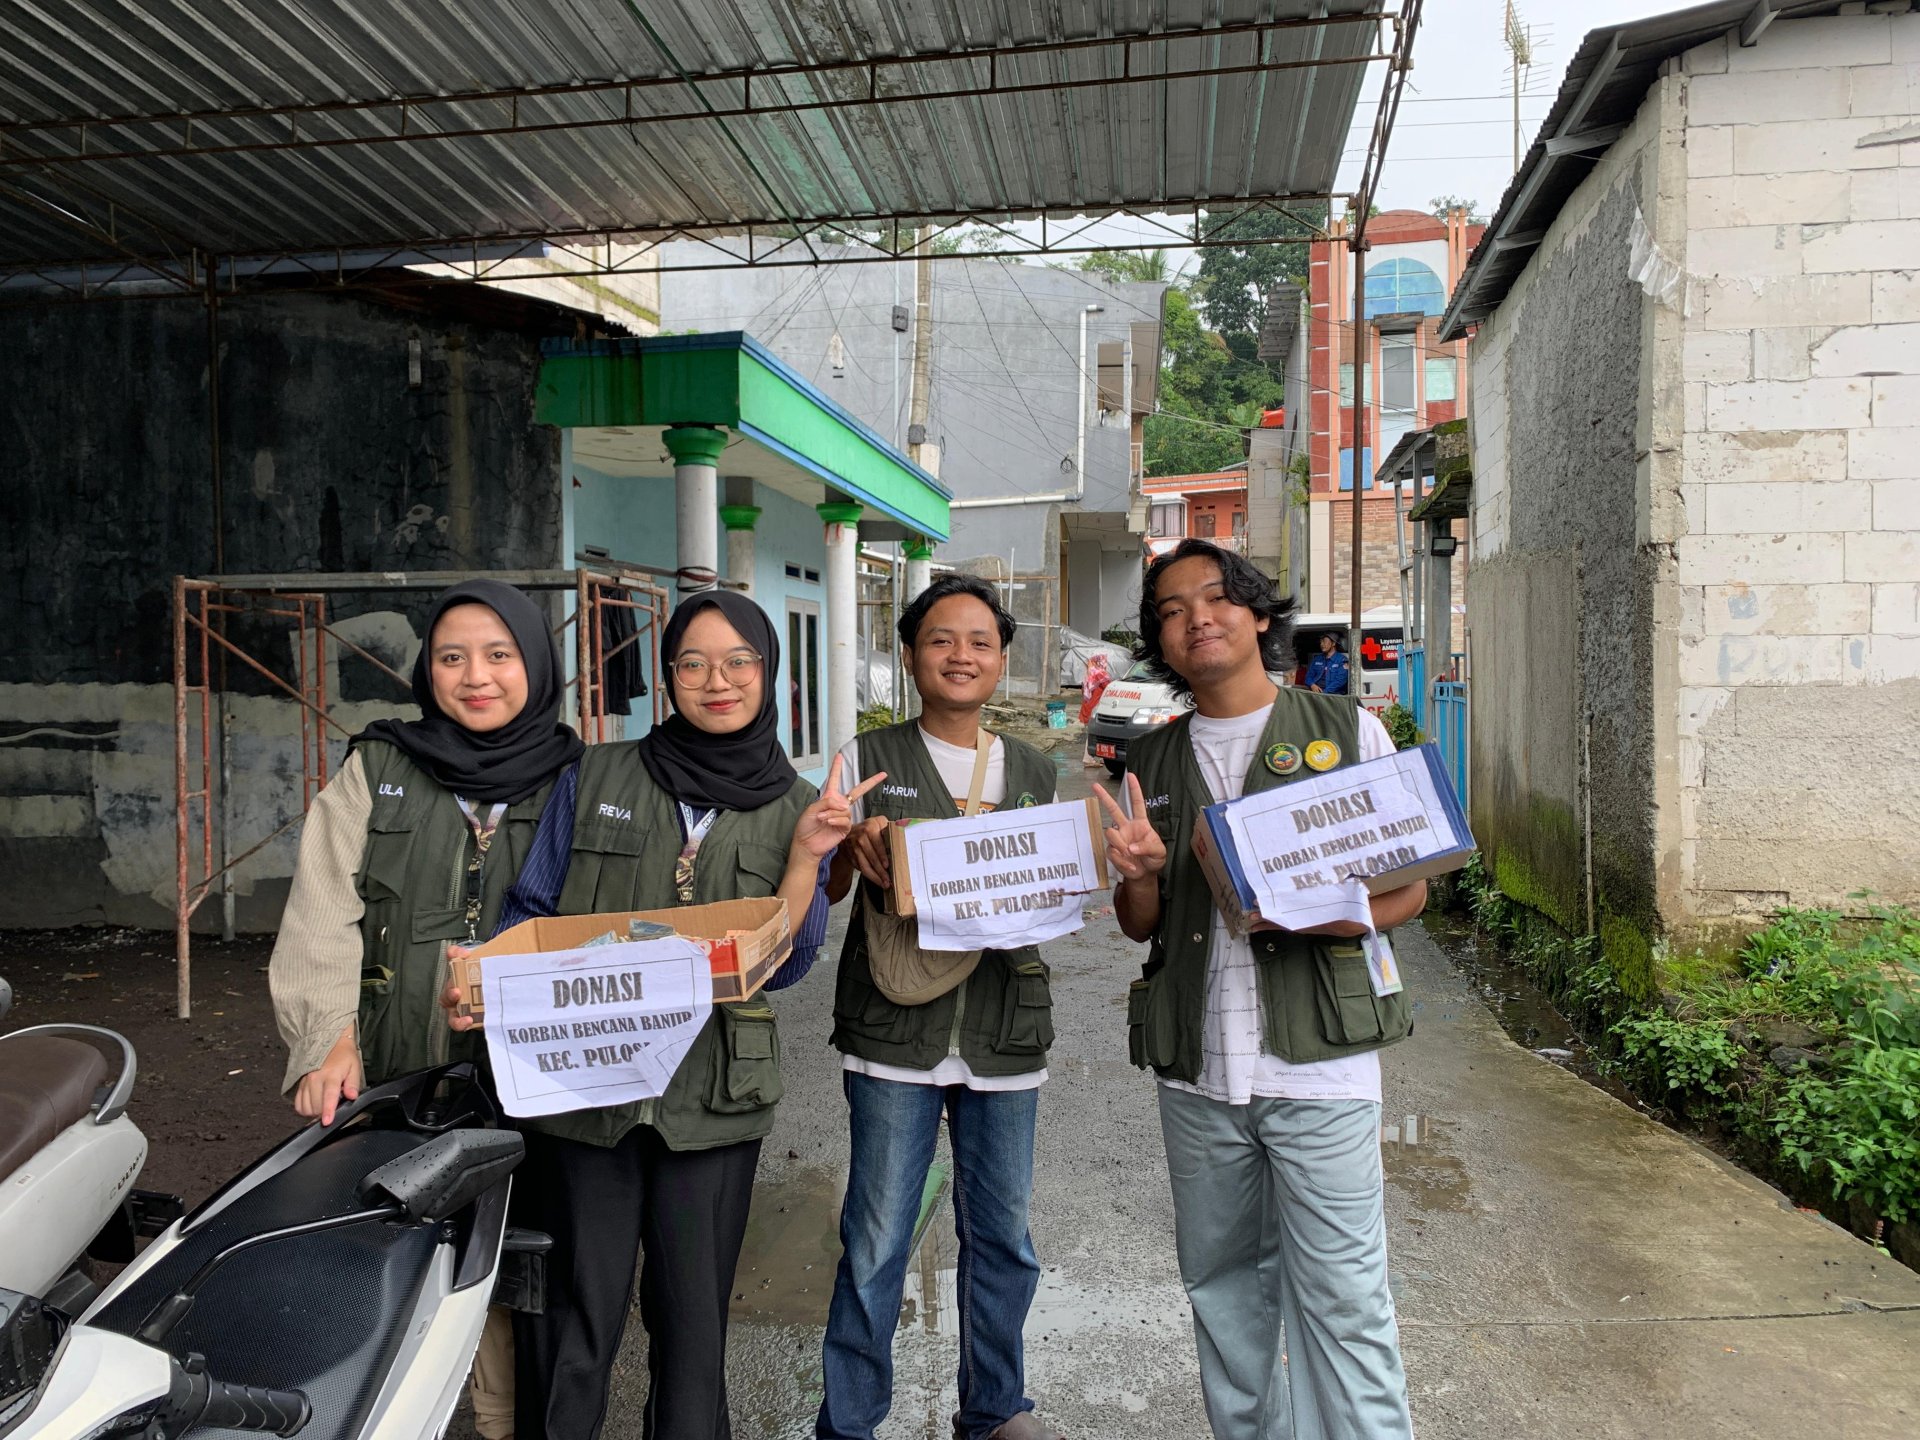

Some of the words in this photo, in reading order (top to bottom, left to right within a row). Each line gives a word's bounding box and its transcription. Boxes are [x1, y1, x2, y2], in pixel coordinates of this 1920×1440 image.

[379, 783, 404, 798] ULA
[882, 784, 918, 798] HARUN
[1145, 794, 1170, 809] HARIS
[598, 803, 632, 821] REVA
[1290, 789, 1377, 834] DONASI
[963, 831, 1038, 864] DONASI
[1261, 845, 1318, 875] KORBAN
[1320, 829, 1379, 857] BENCANA
[1380, 814, 1429, 841] BANJIR
[930, 877, 980, 898] KORBAN
[984, 869, 1035, 890] BENCANA
[1037, 862, 1080, 882] BANJIR
[1290, 870, 1333, 890] KEC.
[953, 899, 989, 921] KEC.
[991, 887, 1065, 916] PULOSARI
[715, 938, 733, 949] pcs
[551, 971, 643, 1009] DONASI
[507, 1023, 569, 1044] KORBAN
[573, 1017, 637, 1039] BENCANA
[536, 1052, 580, 1073] KEC.
